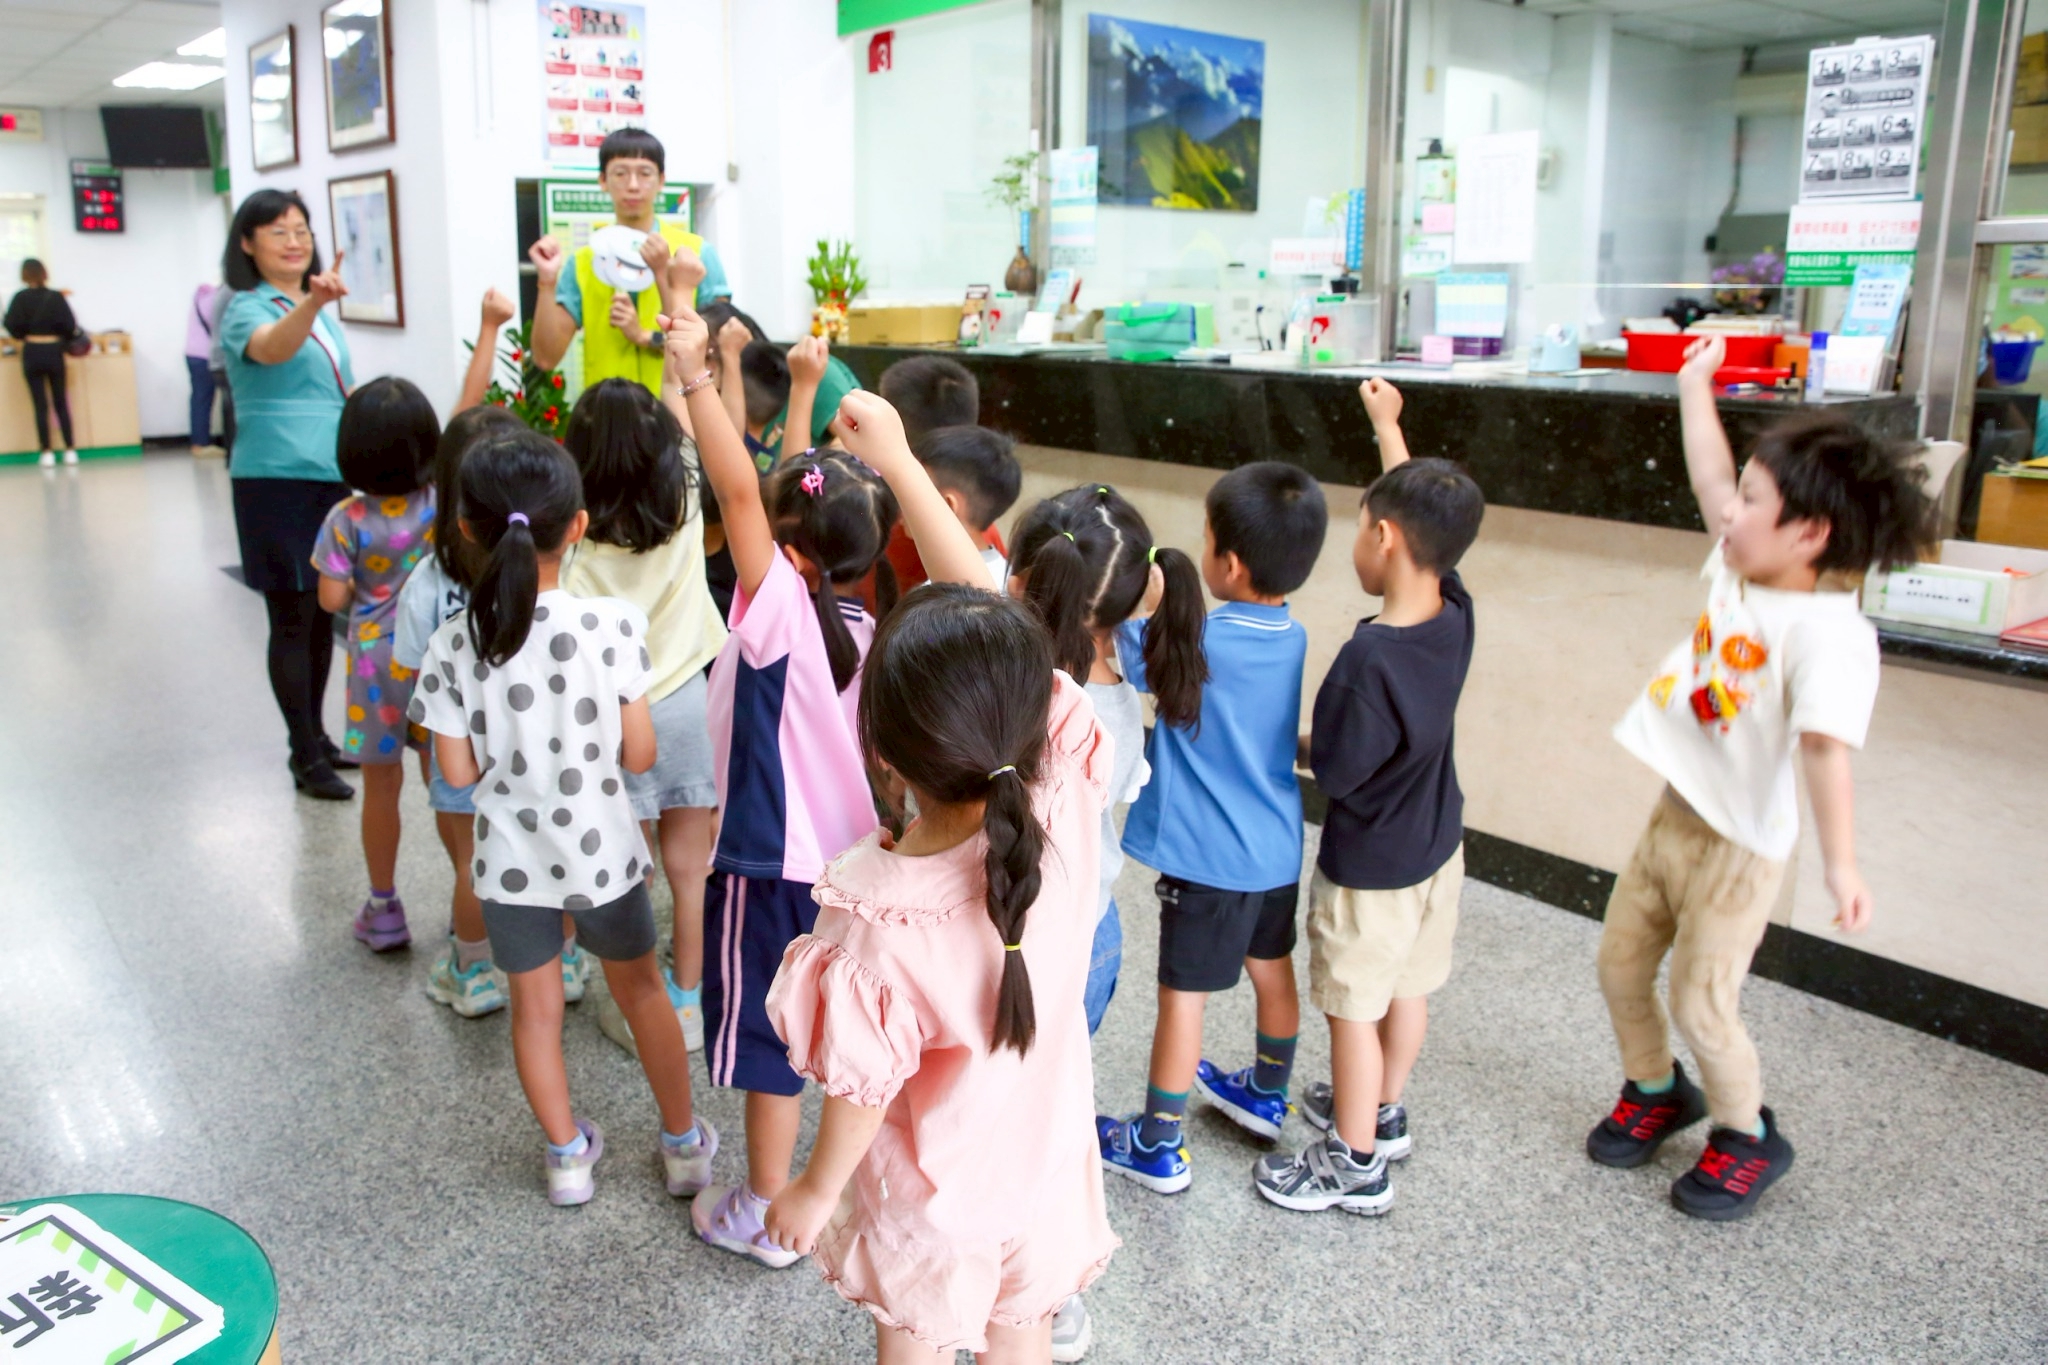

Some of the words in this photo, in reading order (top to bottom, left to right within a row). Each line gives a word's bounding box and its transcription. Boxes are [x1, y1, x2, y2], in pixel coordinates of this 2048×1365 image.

[877, 43, 888, 73] 3
[1818, 58, 1826, 74] 1
[1853, 55, 1864, 72] 2
[1889, 50, 1901, 68] 3
[1810, 122, 1825, 139] 4
[1845, 119, 1857, 136] 5
[1881, 115, 1893, 133] 6
[1809, 154, 1819, 172] 7
[1843, 152, 1854, 169] 8
[1878, 149, 1891, 167] 9
[0, 1269, 104, 1349] 新
